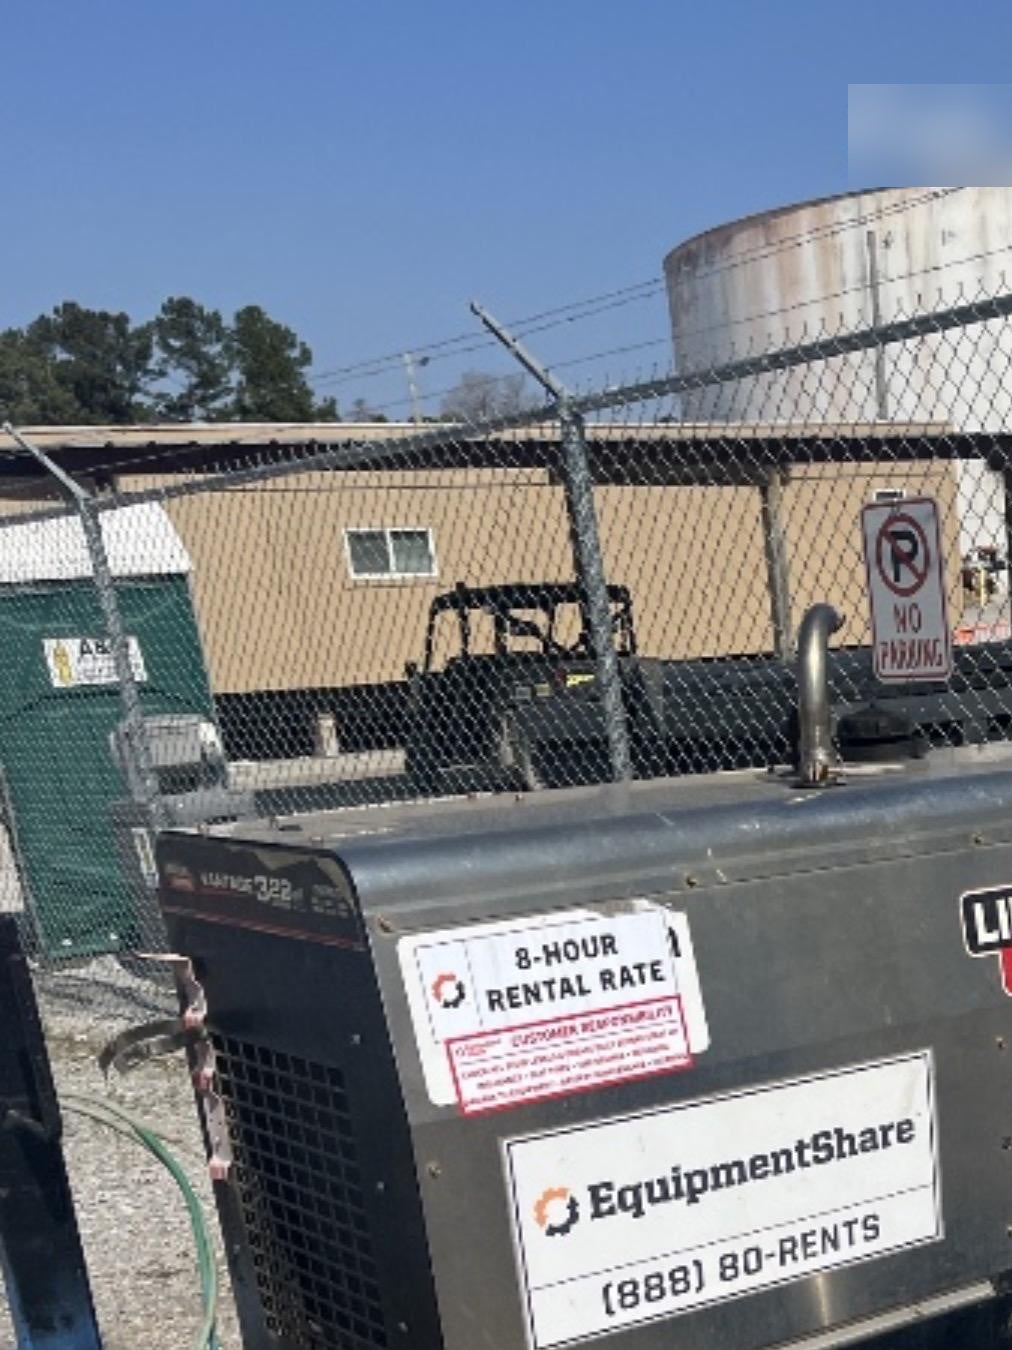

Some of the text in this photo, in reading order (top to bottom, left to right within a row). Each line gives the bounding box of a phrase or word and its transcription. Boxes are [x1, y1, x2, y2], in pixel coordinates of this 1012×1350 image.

[893, 602, 922, 634] NO
[880, 638, 943, 670] PARKING
[254, 874, 292, 902] 322
[515, 933, 619, 970] 8-HOUR
[486, 959, 666, 1012] RENTAL RATE
[586, 1115, 916, 1221] EquipmentShare
[602, 1213, 881, 1316] (888) 80-RENTS
